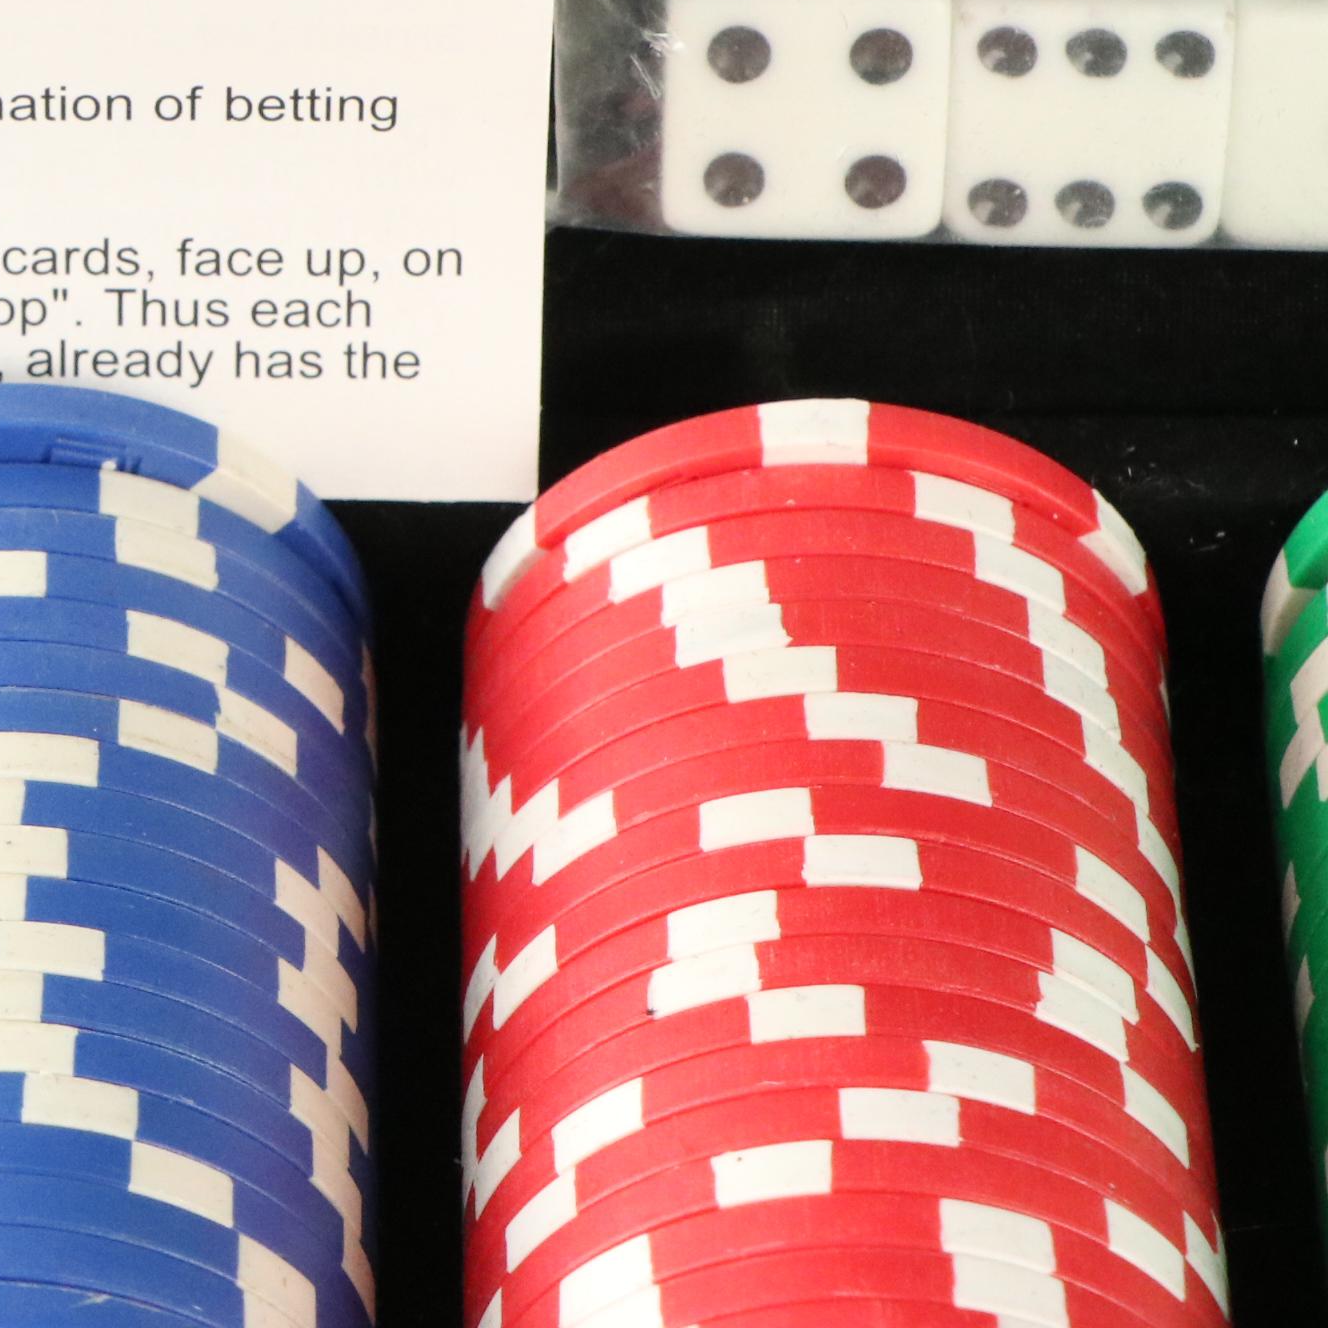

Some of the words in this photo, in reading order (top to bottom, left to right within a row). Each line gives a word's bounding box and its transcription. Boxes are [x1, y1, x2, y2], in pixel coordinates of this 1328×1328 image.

[154, 85, 204, 122] of
[225, 86, 398, 132] betting
[2, 237, 154, 282] cards,
[176, 237, 284, 277] face
[306, 248, 379, 287] up,
[403, 247, 462, 277] on
[104, 288, 230, 328] Thus
[250, 289, 371, 328] each
[26, 339, 214, 389] already
[235, 340, 323, 379] has
[343, 341, 421, 380] the
